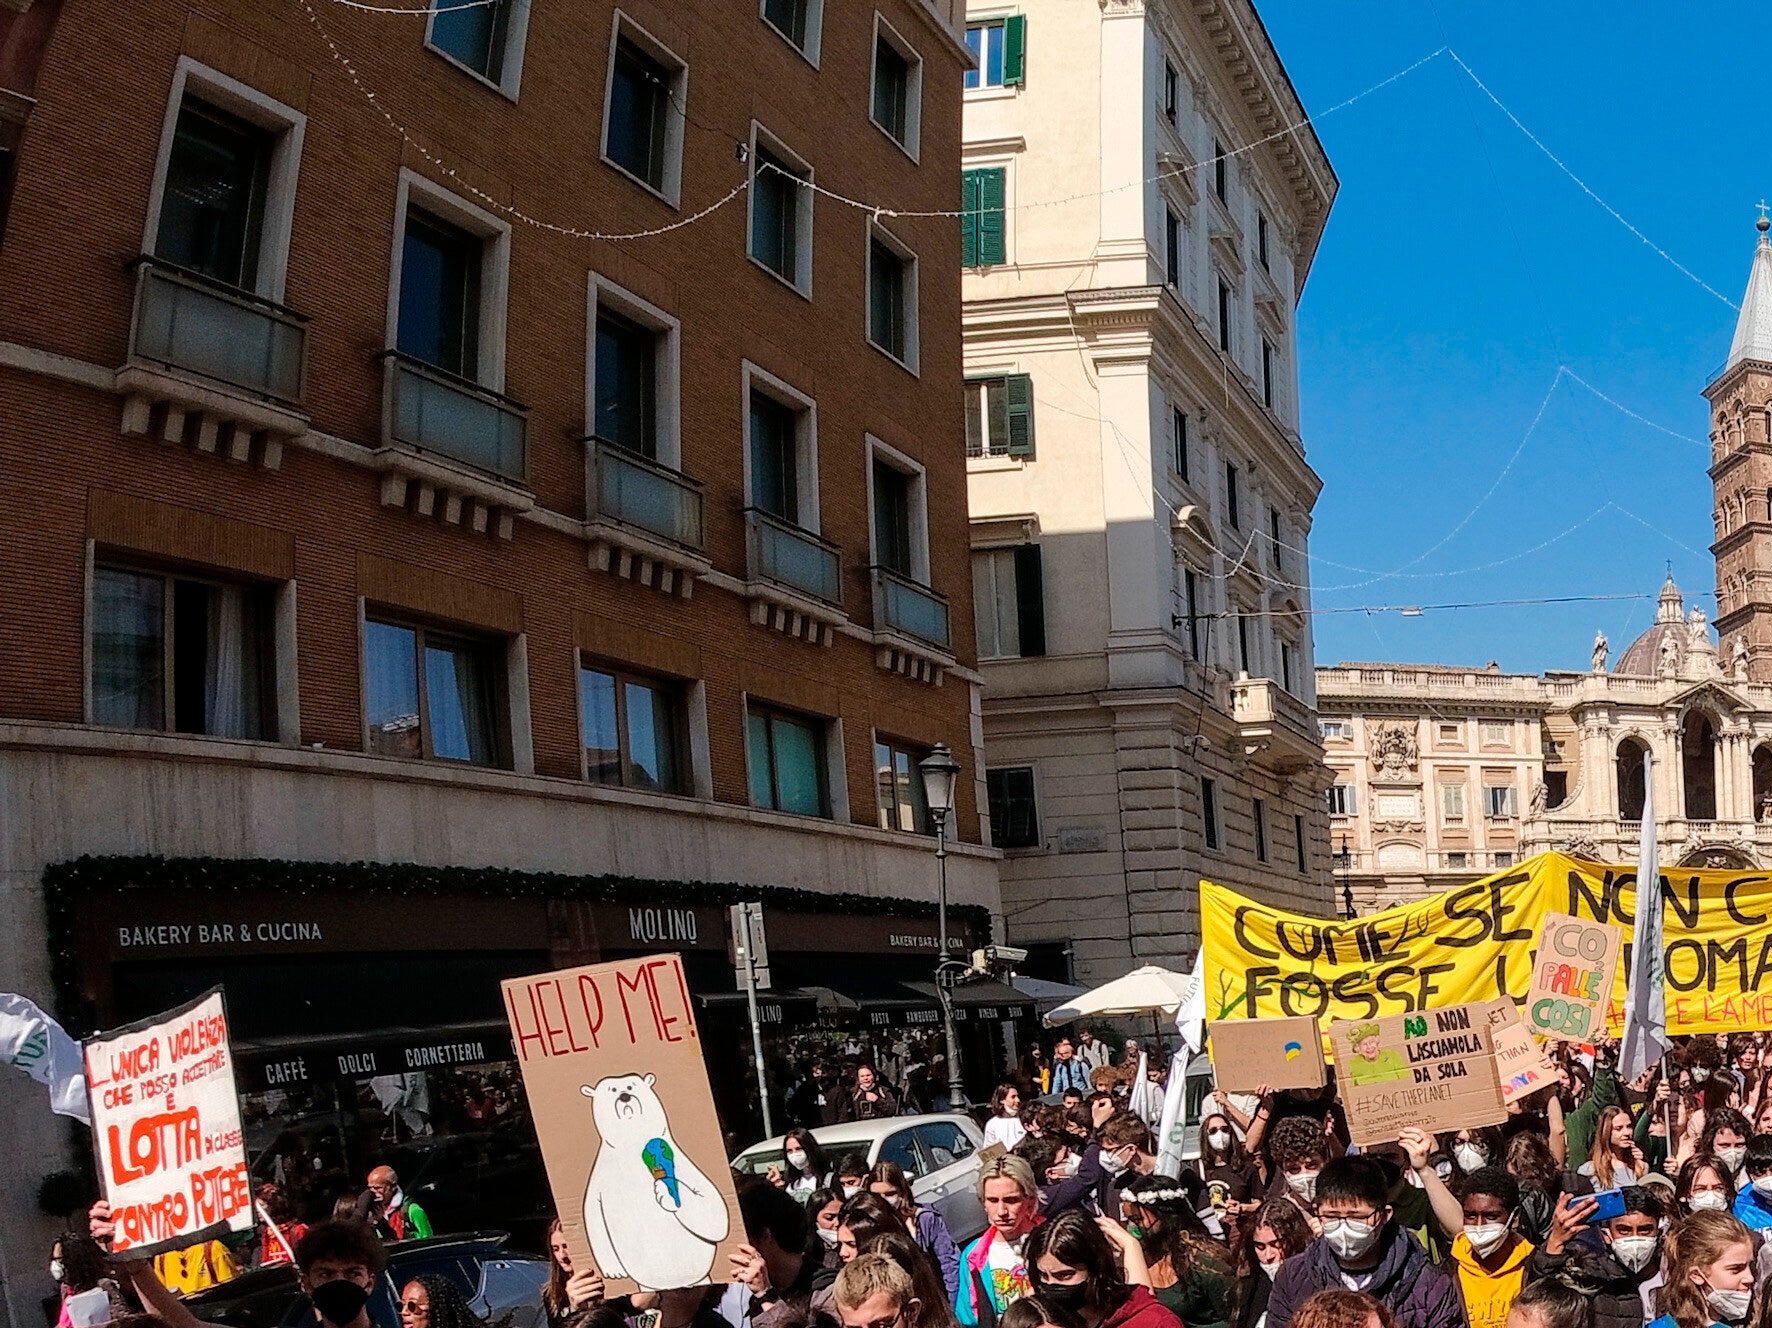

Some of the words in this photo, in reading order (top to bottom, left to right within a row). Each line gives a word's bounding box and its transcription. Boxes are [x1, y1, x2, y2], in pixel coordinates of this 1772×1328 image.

[629, 908, 698, 944] MOLINO
[1235, 905, 1411, 966] COME
[1434, 872, 1533, 948] SE
[1567, 870, 1700, 929] NON
[119, 924, 192, 946] BAKERY
[199, 923, 235, 944] BAR
[240, 923, 251, 942] &
[257, 922, 322, 942] CUCINA
[889, 934, 917, 948] BAKERY
[1246, 962, 1456, 1020] FOSSE
[1539, 961, 1604, 1001] PALLE
[507, 974, 604, 1062] HELP
[616, 959, 696, 1044] ME!
[747, 1004, 782, 1025] OLINO
[871, 1012, 890, 1025] PASTA
[1435, 1007, 1471, 1033] NON
[168, 1013, 226, 1064] VIOLENZA
[1406, 1033, 1483, 1064] LASCIAMOLA
[1496, 1041, 1530, 1062] THAN
[338, 1052, 377, 1076] DOLCI
[405, 1041, 485, 1068] CORNETTERIA
[265, 1055, 309, 1085] CAFFÈ
[1413, 1066, 1432, 1084] DA
[1437, 1060, 1468, 1080] SOLA
[103, 1083, 133, 1110] CHE
[140, 1072, 177, 1100] POSSO
[108, 1105, 202, 1186] LOTTA
[110, 1192, 189, 1253] CONTRO
